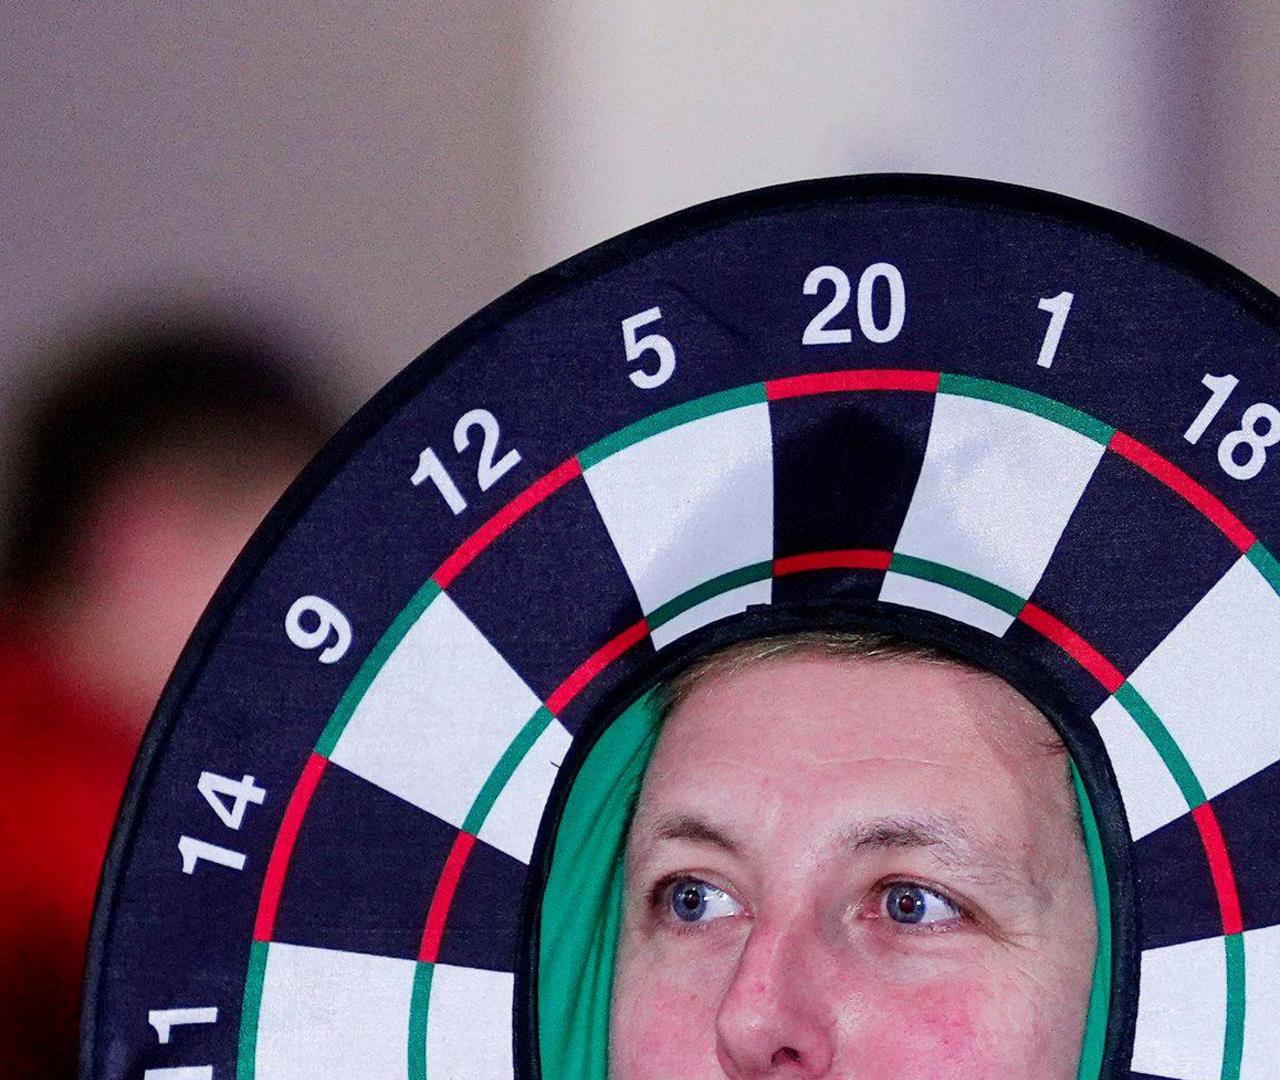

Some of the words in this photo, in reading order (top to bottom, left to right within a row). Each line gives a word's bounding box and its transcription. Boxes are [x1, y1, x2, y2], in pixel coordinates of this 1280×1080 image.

[801, 262, 906, 345] 20
[1036, 291, 1074, 369] 1
[621, 306, 677, 390] 5
[410, 408, 522, 516] 12
[284, 595, 352, 664] 9
[177, 770, 267, 875] 14
